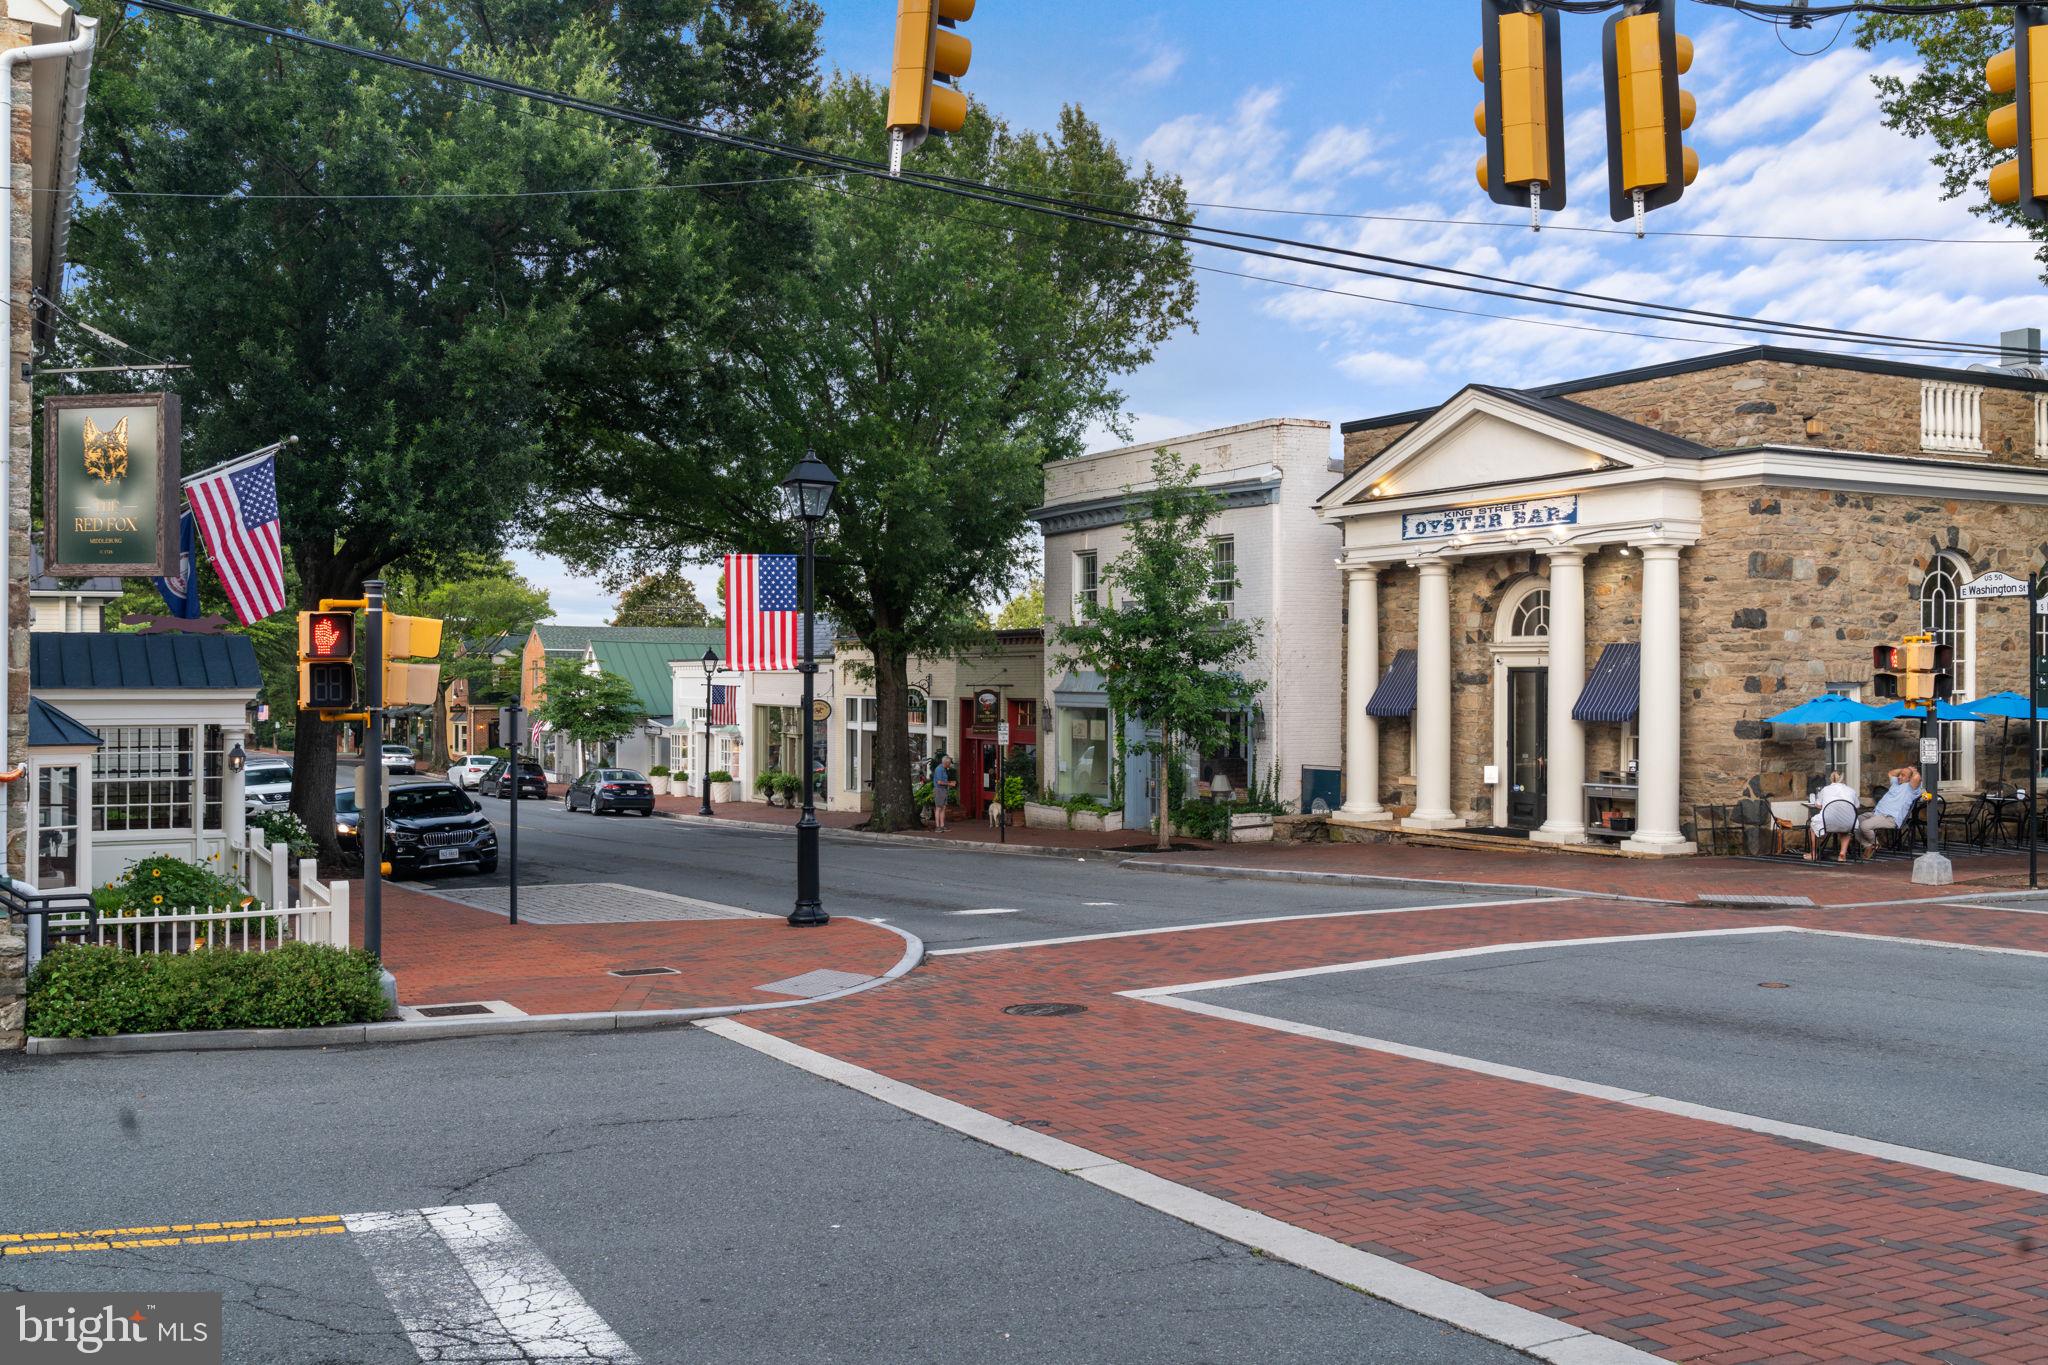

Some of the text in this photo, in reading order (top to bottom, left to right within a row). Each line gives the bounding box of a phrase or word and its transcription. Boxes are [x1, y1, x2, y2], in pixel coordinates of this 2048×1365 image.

[1444, 503, 1527, 519] KING STREET
[74, 516, 139, 532] RED FOX
[1415, 506, 1562, 535] OYSTER BAR
[1962, 584, 2026, 596] E Washington St
